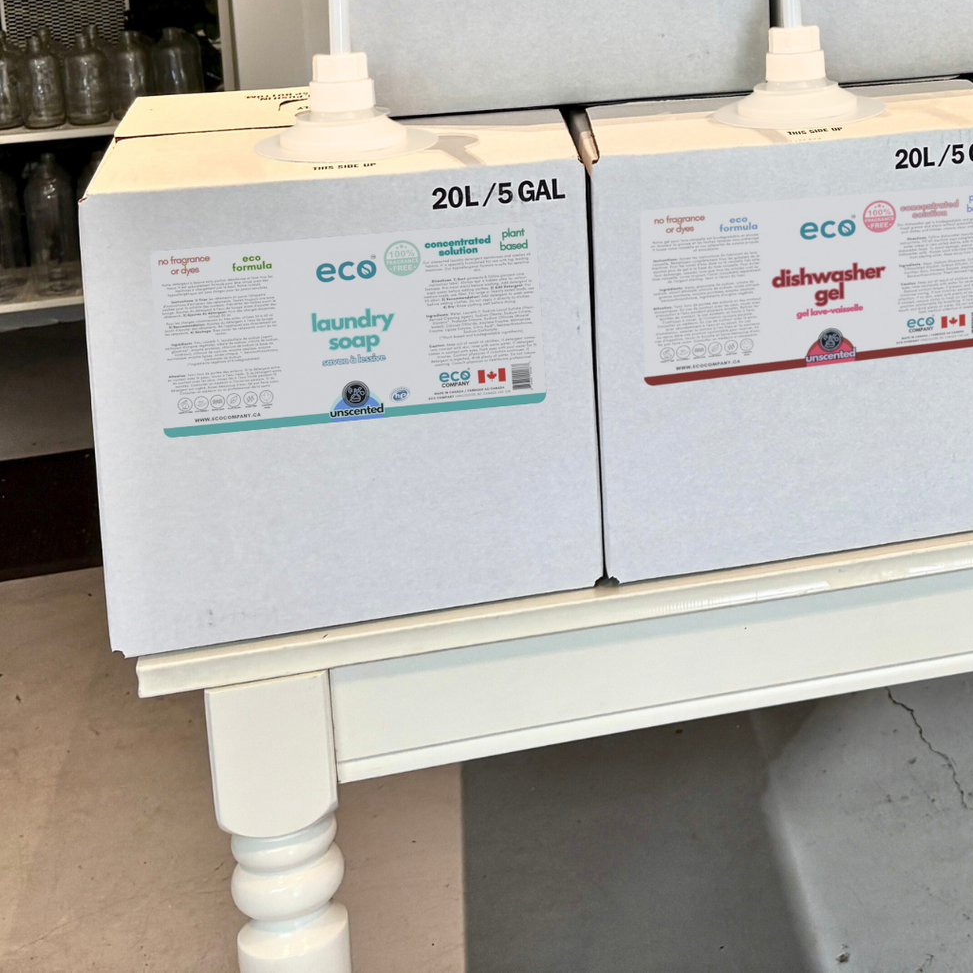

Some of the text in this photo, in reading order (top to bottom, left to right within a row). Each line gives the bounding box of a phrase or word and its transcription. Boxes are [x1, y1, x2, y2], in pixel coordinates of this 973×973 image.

[518, 178, 566, 203] GAL
[867, 207, 892, 217] 100%
[654, 214, 706, 227] no fragrance
[729, 216, 748, 224] eco
[870, 221, 889, 229] FREE
[501, 227, 526, 240] plant
[665, 223, 695, 235] or dyes
[719, 222, 758, 233] formula
[799, 219, 856, 240] eco
[424, 234, 492, 249] concentrated
[499, 238, 529, 252] based
[388, 249, 415, 259] 100%
[438, 246, 479, 257] solution
[158, 254, 211, 268] no fragrance
[242, 255, 261, 263] eco
[385, 257, 419, 266] FRAGRANCE
[170, 265, 200, 277] or dyes
[232, 260, 273, 273] formula
[315, 258, 377, 283] eco
[393, 264, 414, 273] FREE
[771, 262, 887, 288] dishwasher
[814, 282, 845, 308] gel
[796, 303, 864, 320] gel lave-vaisselle
[311, 308, 396, 333] laundry
[906, 316, 935, 329] eco
[328, 332, 381, 353] soap
[357, 352, 387, 364] lessive
[805, 346, 857, 363] unscented
[675, 358, 741, 371] WWW.ECOCOMPANY.CA
[438, 370, 471, 383] eco
[441, 380, 470, 389] COMPANY
[330, 403, 385, 418] unscented
